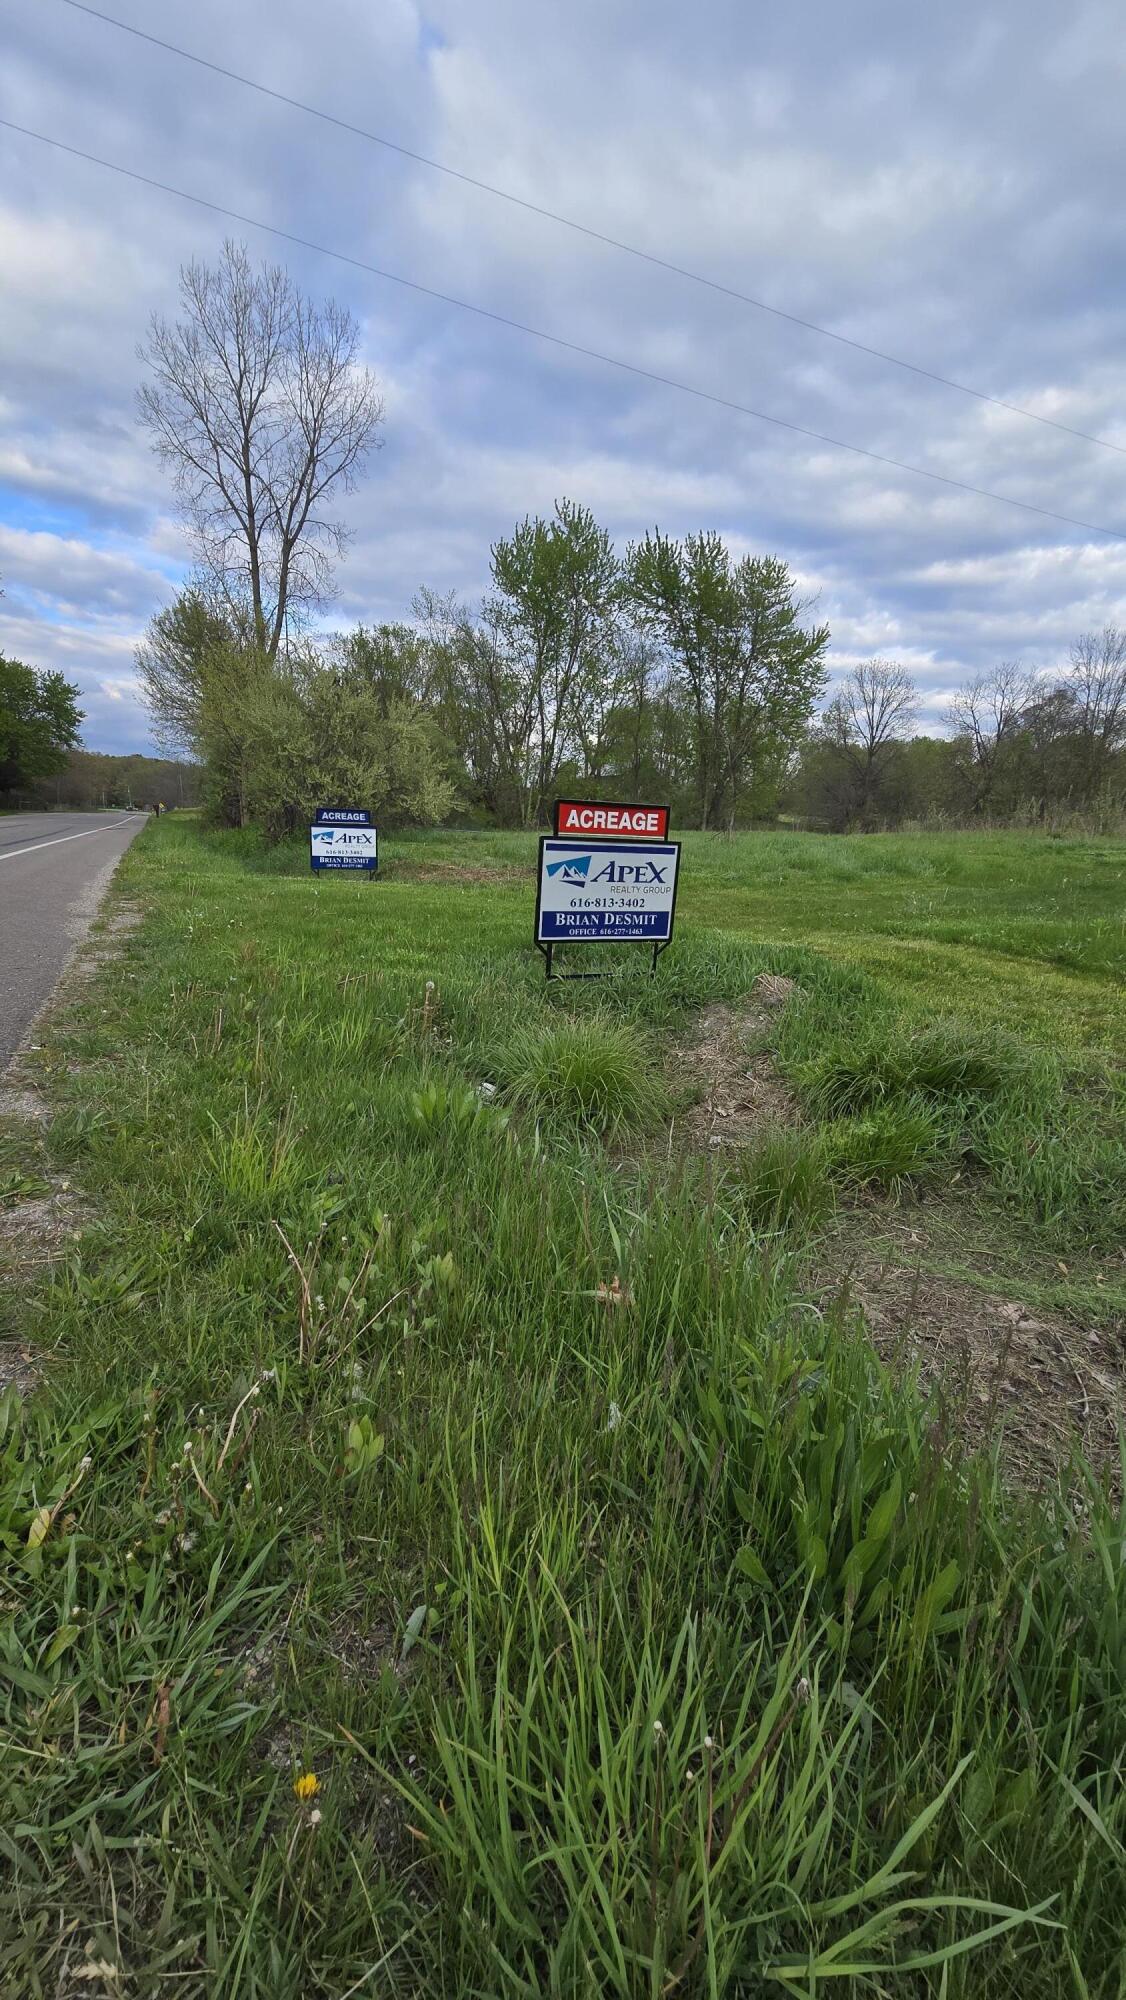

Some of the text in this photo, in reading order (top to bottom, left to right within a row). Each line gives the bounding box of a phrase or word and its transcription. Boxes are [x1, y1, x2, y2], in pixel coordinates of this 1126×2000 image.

[322, 812, 366, 820] ACREAGE
[566, 809, 658, 831] ACREAGE
[335, 833, 373, 844] APEX
[590, 860, 668, 884] APEX
[610, 886, 641, 894] REALTY
[555, 913, 599, 926] BRIAN
[569, 928, 597, 936] OFFICE
